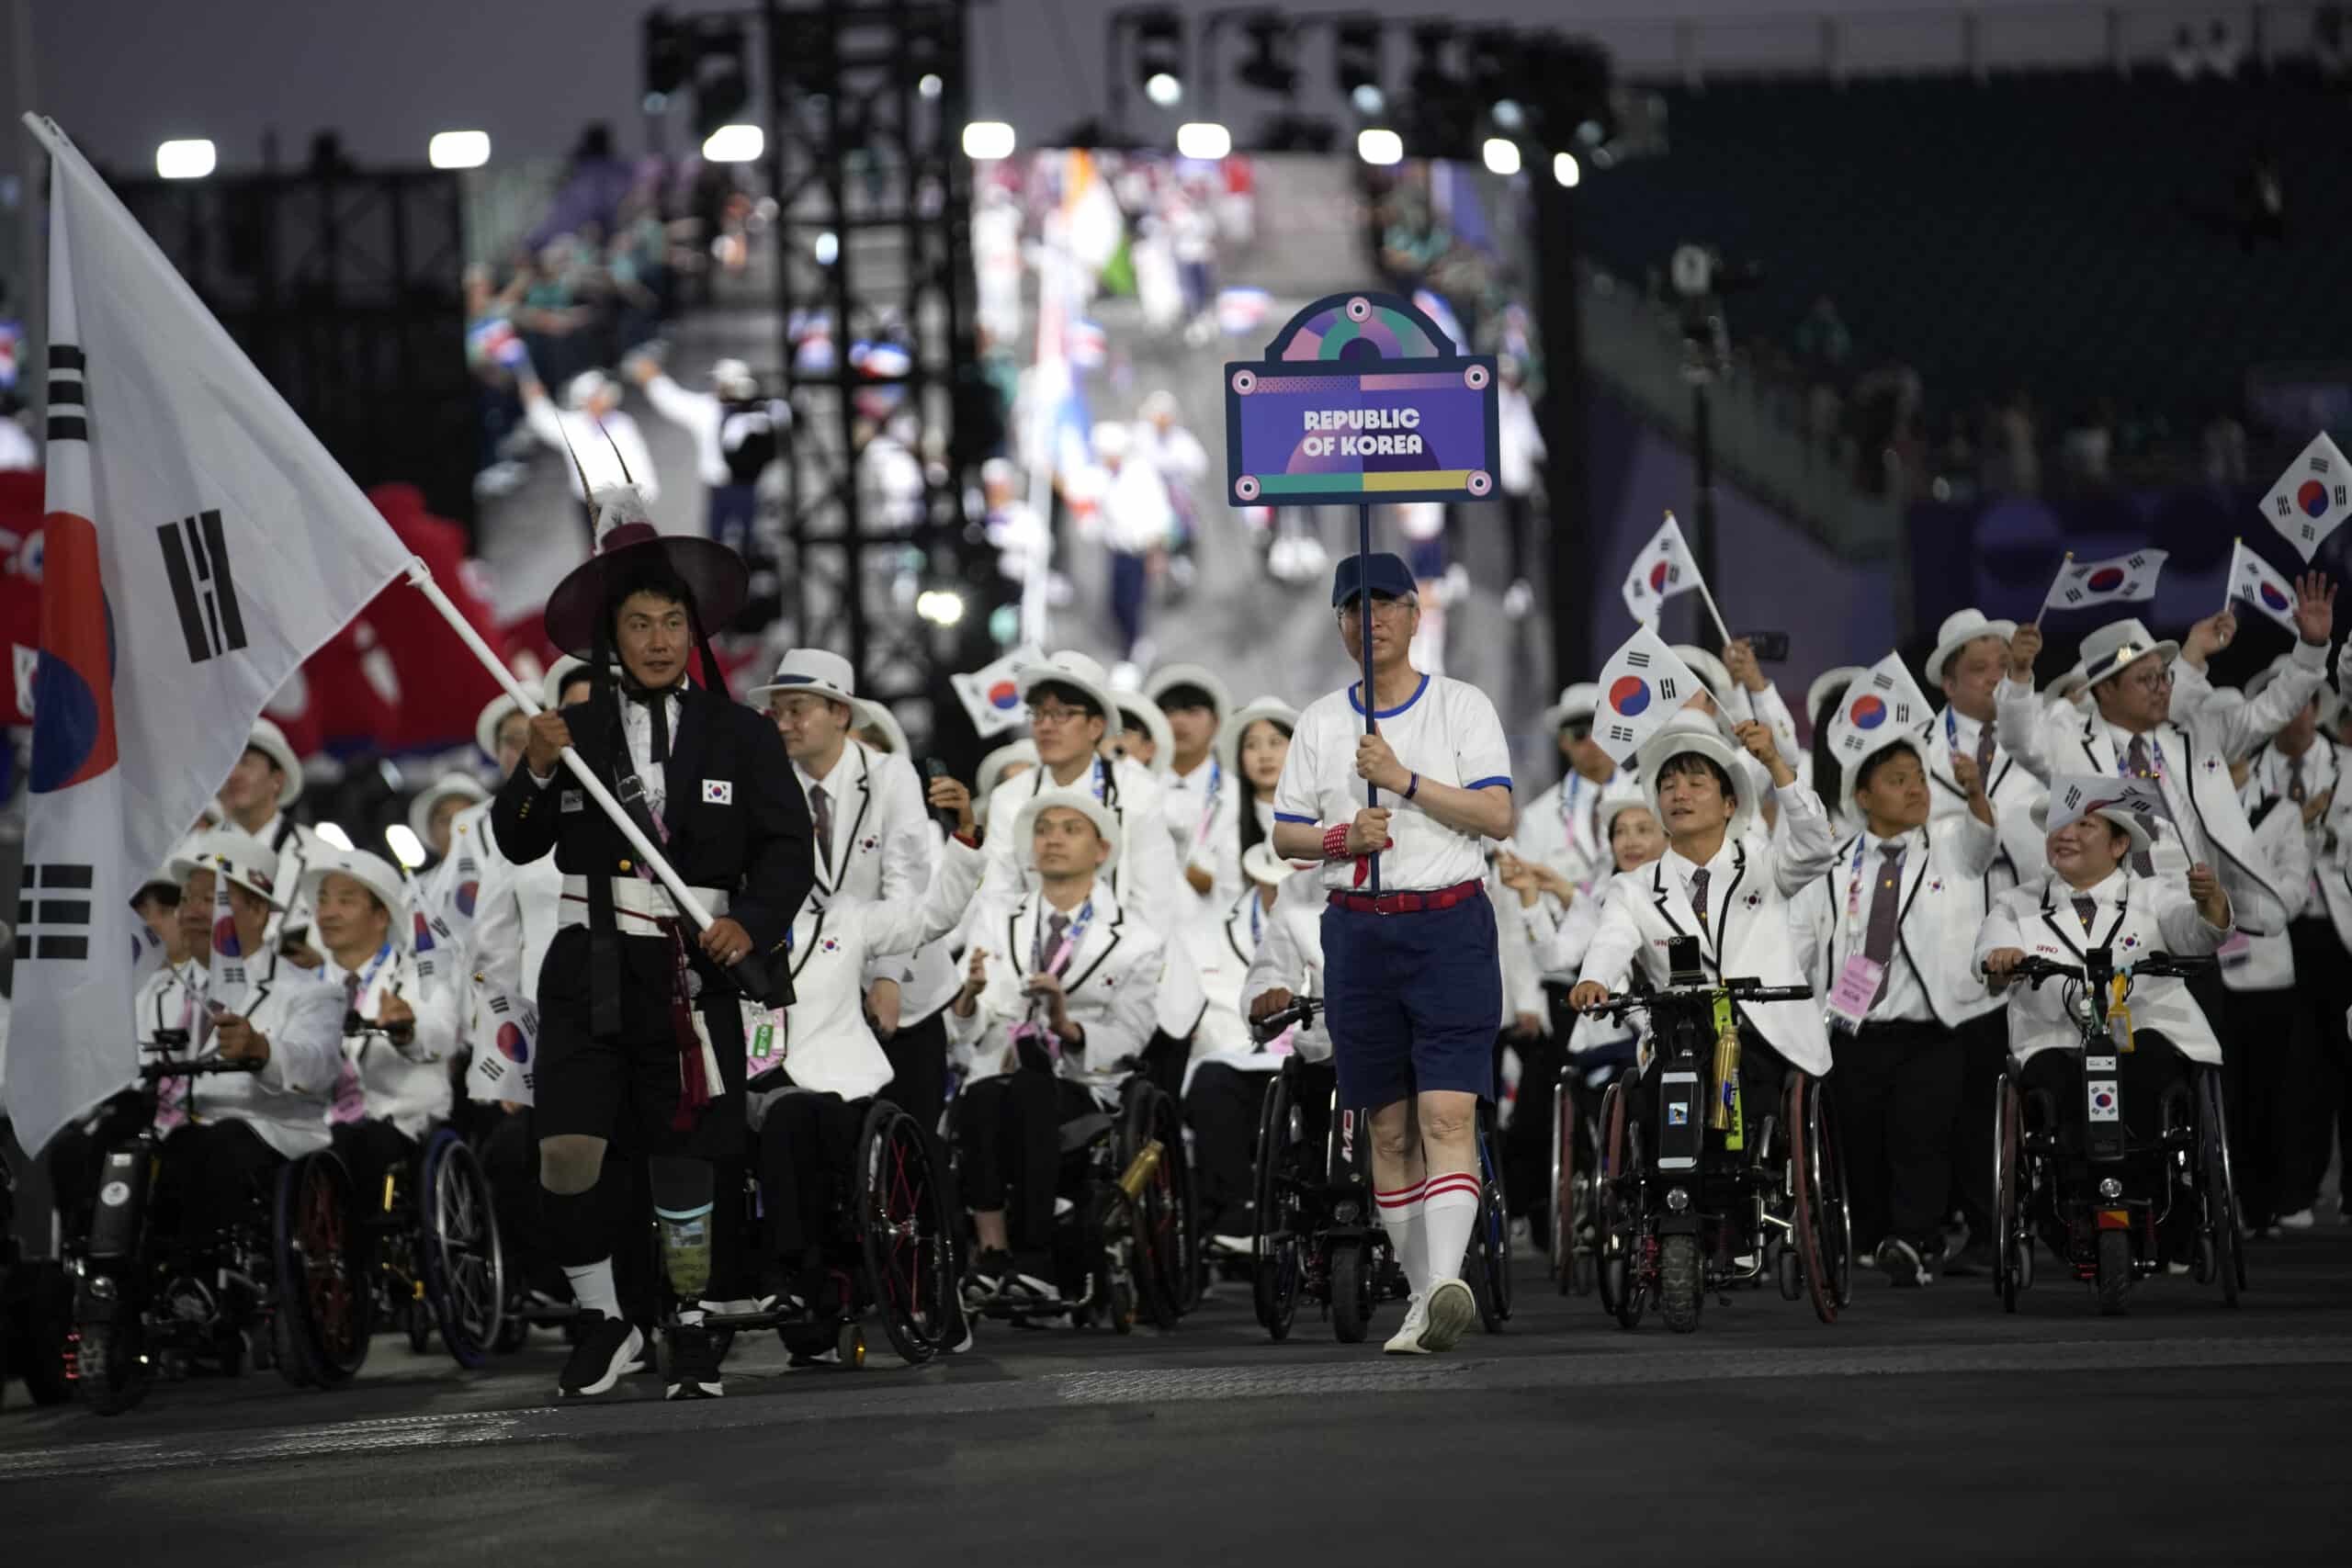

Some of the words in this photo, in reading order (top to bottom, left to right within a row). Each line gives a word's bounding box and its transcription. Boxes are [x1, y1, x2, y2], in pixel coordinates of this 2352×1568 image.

[1304, 408, 1420, 431] REPUBLIC
[1303, 436, 1335, 457] OF
[1340, 434, 1423, 456] KOREA
